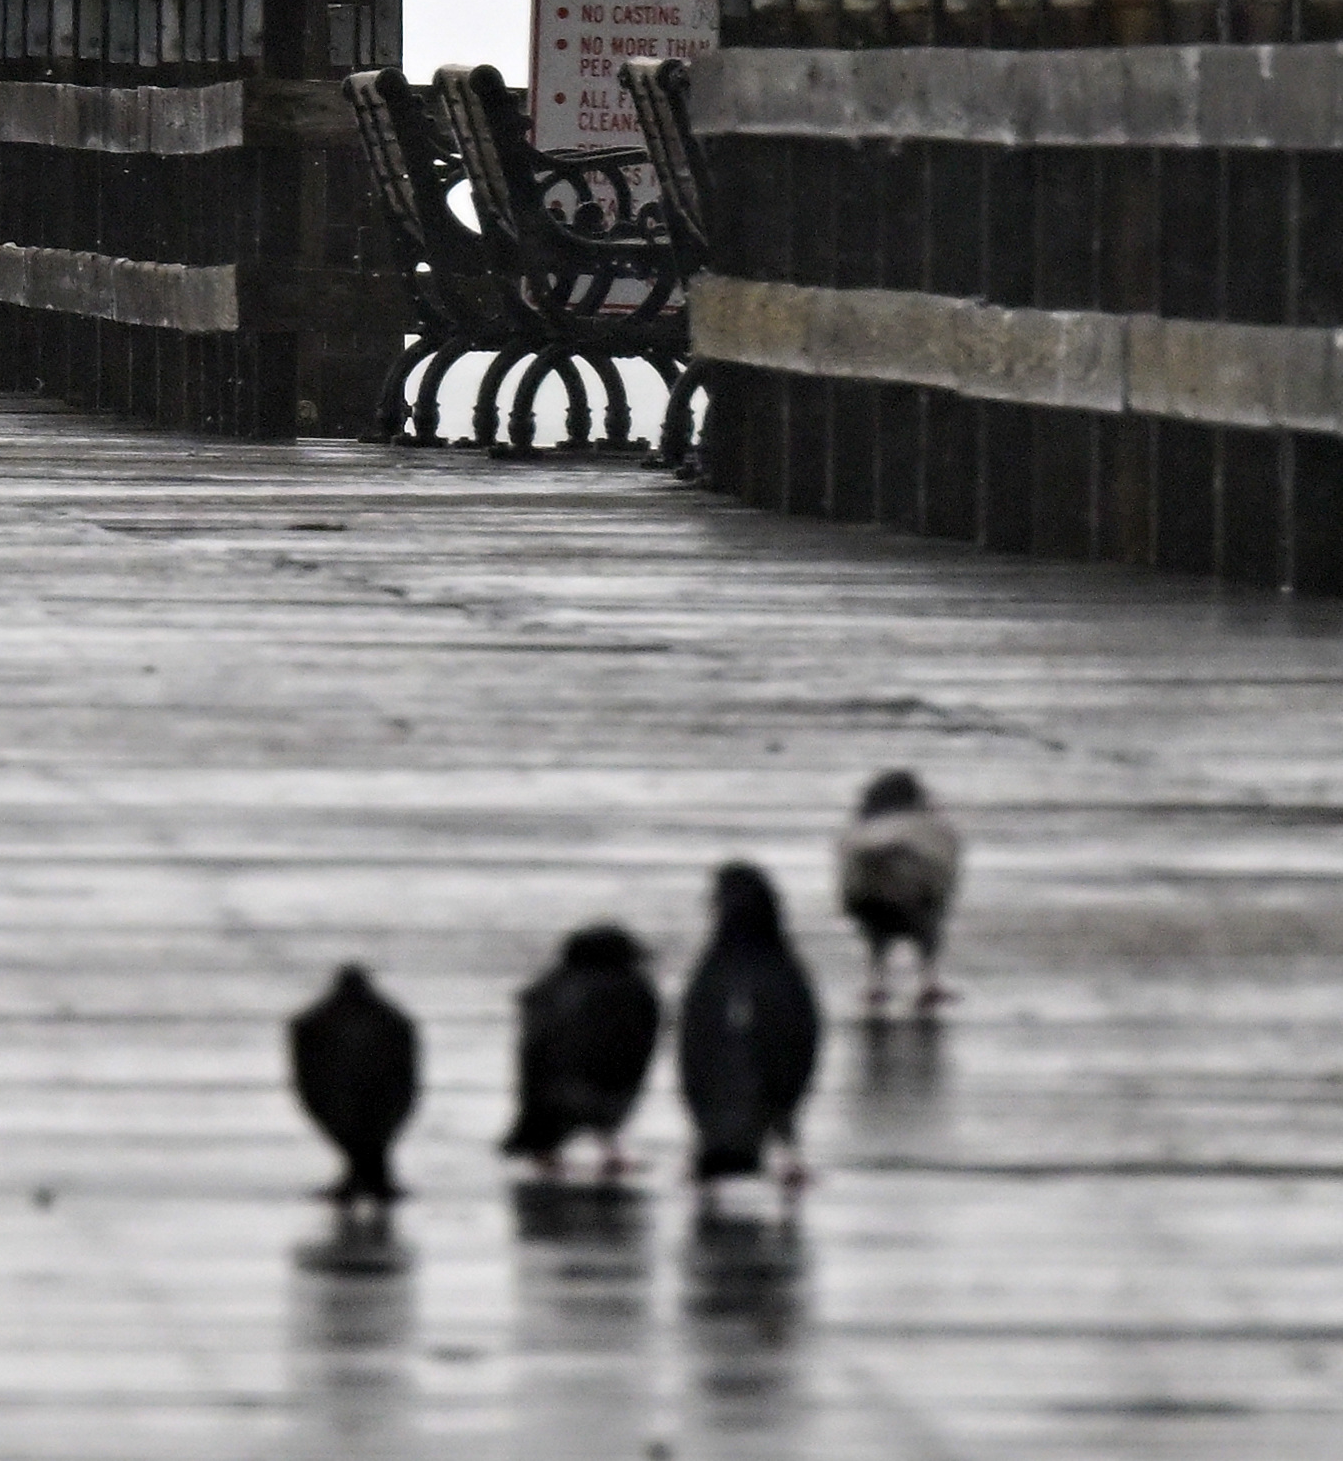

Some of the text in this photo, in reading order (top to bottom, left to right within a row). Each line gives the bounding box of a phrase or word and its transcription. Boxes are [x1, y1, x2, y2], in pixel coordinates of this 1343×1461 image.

[581, 5, 604, 23] NO
[580, 36, 603, 55] NO
[611, 36, 658, 56] MORE
[580, 58, 612, 77] PER
[580, 90, 610, 109] ALL
[578, 112, 639, 132] CLEAN
